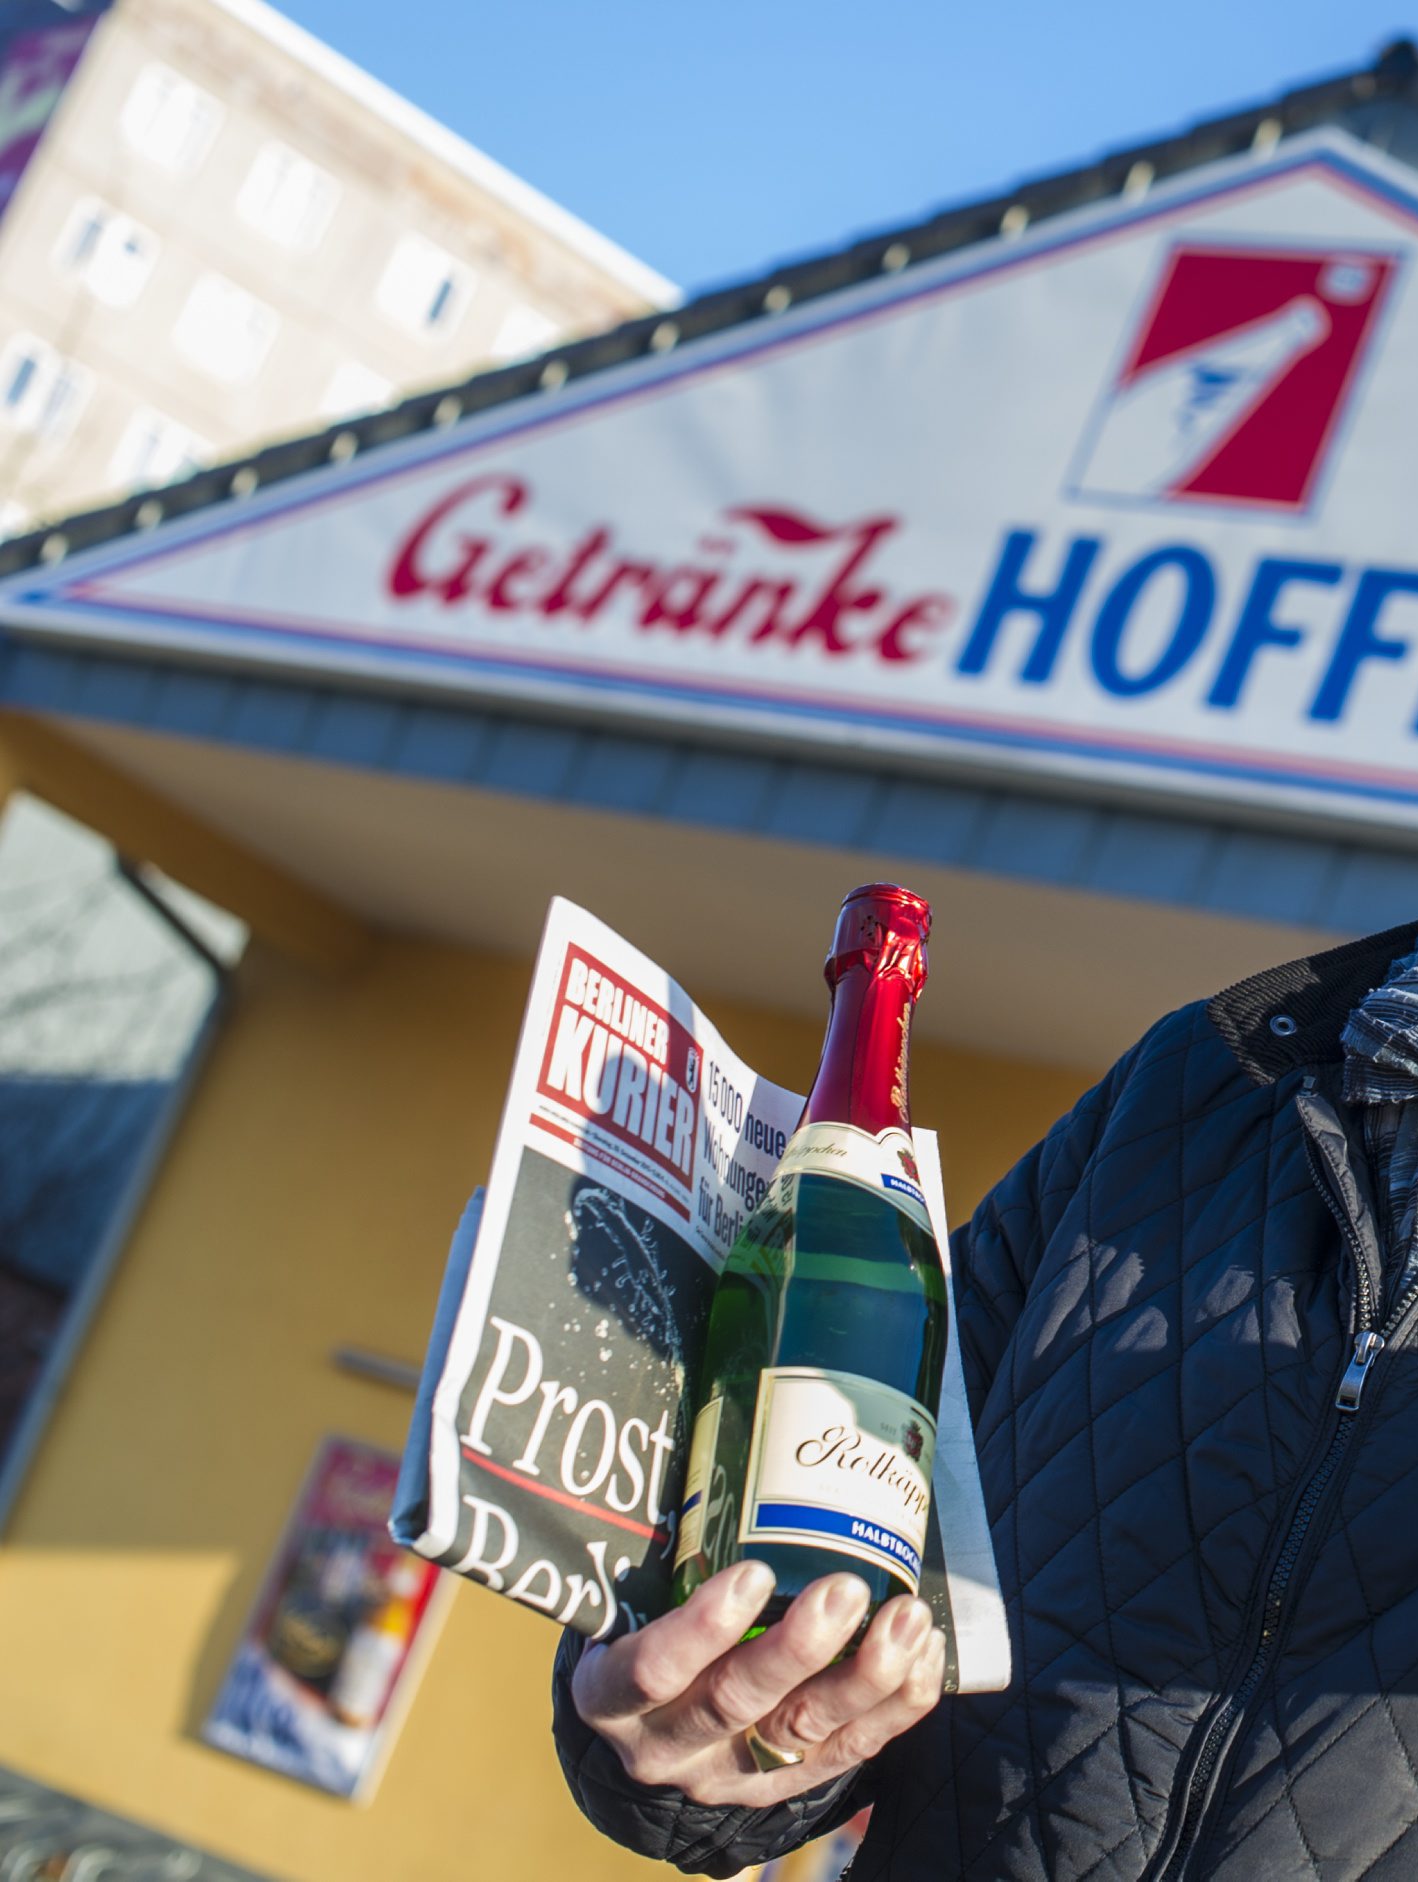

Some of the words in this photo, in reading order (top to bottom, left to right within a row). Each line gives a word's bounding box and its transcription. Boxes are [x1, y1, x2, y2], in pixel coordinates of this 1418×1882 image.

[386, 470, 957, 667] Getränke
[564, 957, 669, 1066] BERLINER
[546, 1003, 695, 1177] KURIER
[744, 1108, 787, 1160] neue
[702, 1115, 770, 1213] Wohnunge
[698, 1176, 714, 1228] für
[714, 1194, 745, 1247] Berli
[795, 1425, 928, 1515] Rotkäpp
[851, 1521, 921, 1571] HALBTROC
